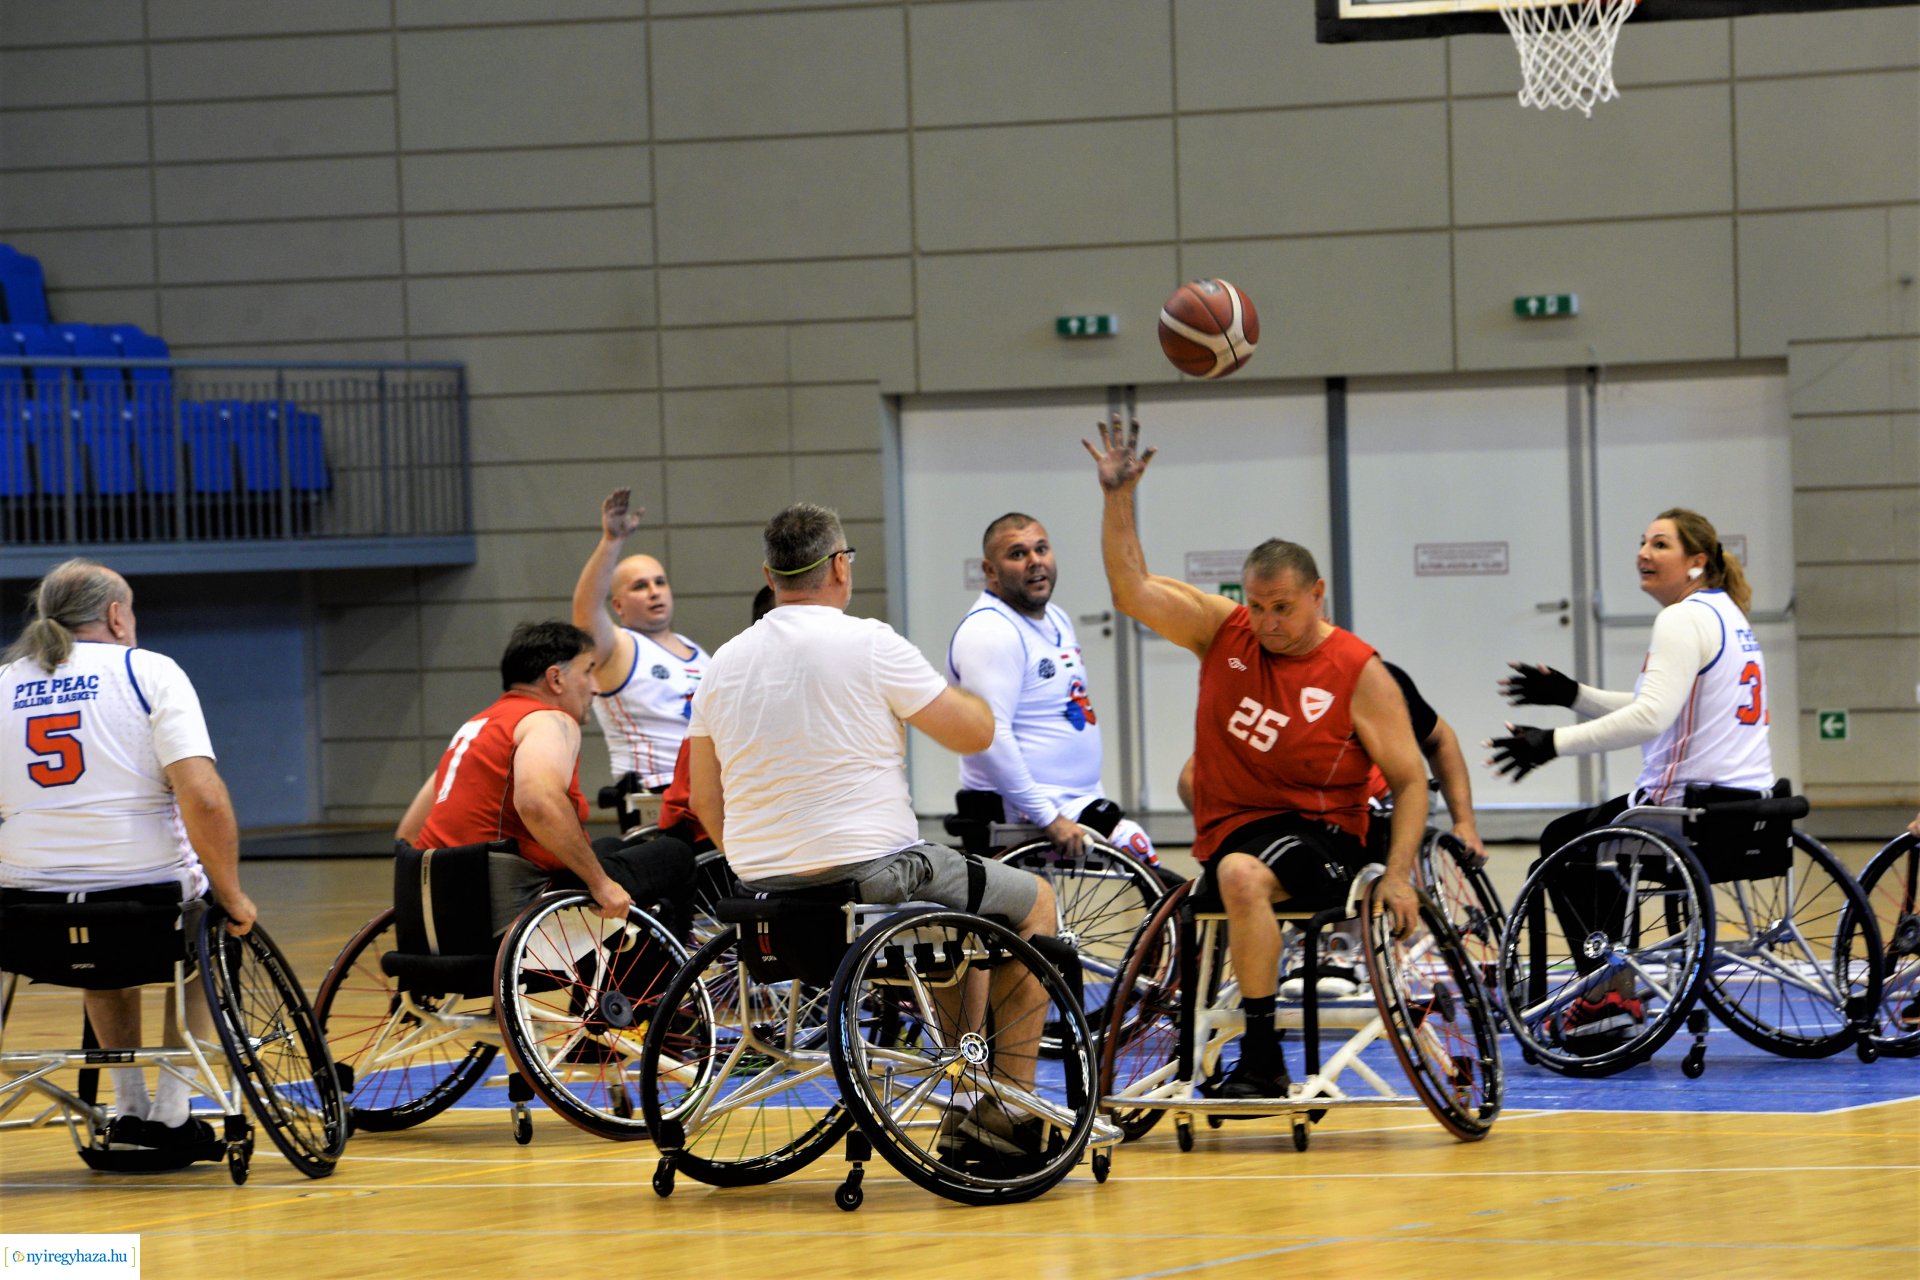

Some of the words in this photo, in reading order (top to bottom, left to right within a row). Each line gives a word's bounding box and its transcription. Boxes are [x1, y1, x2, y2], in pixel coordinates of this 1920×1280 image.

[15, 680, 47, 700] PTE
[51, 675, 99, 693] PEAC
[57, 691, 99, 704] BASKET
[1736, 661, 1770, 725] 3
[26, 711, 86, 788] 5
[1227, 696, 1291, 752] 25
